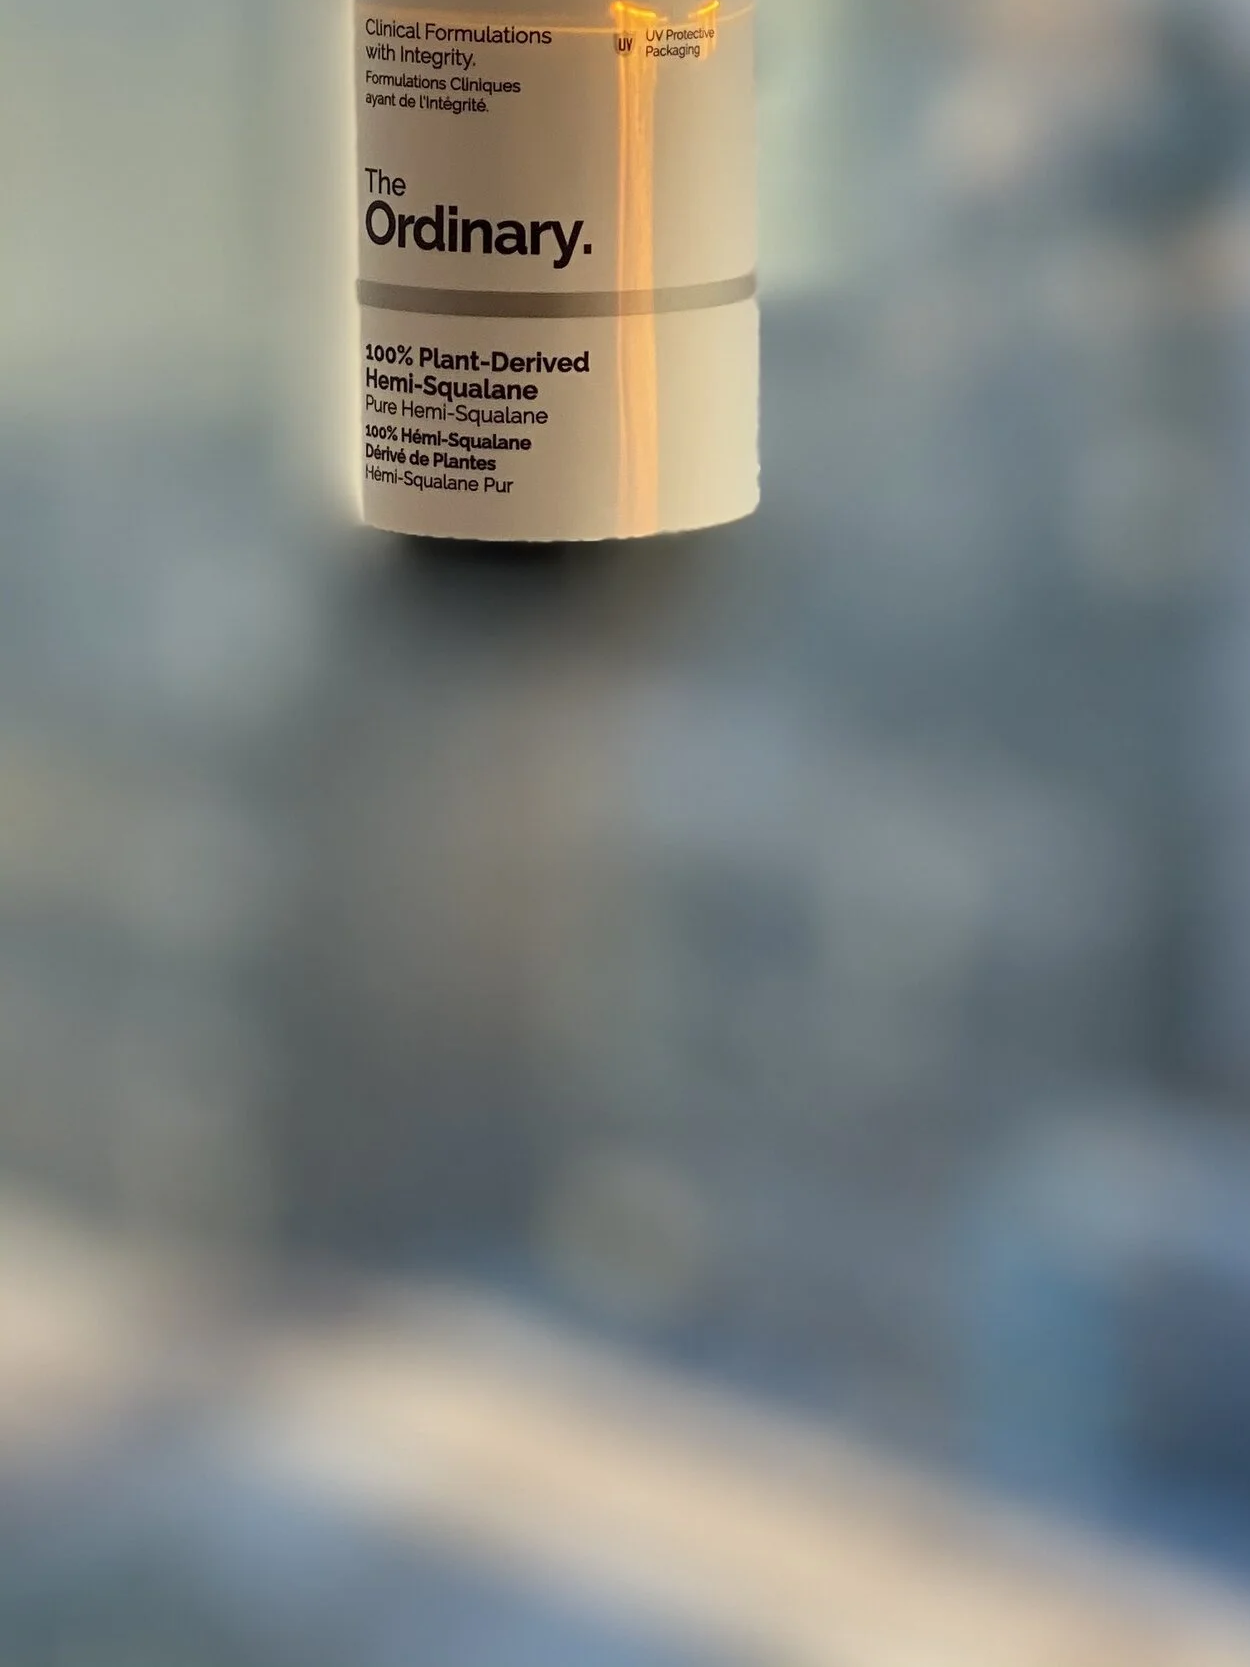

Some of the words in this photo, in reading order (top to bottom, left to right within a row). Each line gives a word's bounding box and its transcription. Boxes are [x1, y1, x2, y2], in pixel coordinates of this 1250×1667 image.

[365, 18, 421, 40] Clinical
[425, 22, 553, 45] Formulations
[618, 37, 633, 52] UV
[645, 28, 664, 42] UV
[665, 27, 715, 41] Protective
[365, 42, 396, 62] with
[400, 45, 477, 70] Integrity.
[645, 43, 700, 59] Packaging
[365, 69, 447, 90] Formulations
[450, 76, 522, 96] Cliniques
[365, 92, 396, 108] ayant
[399, 93, 416, 109] de
[364, 167, 407, 197] The
[365, 199, 593, 269] Ordinary.
[365, 343, 414, 367] 100%
[419, 347, 590, 373] Plant-Derived
[366, 366, 539, 403] Hemi-Squalane
[365, 394, 398, 416] Pure
[401, 399, 549, 427] Hemi-Squalane
[365, 423, 398, 442] 100%
[401, 427, 532, 452] Hémi-Squalane
[365, 442, 407, 464] Dérivé
[409, 449, 430, 467] de
[433, 452, 497, 471] Plantes
[365, 463, 479, 492] Hémi-Squalane
[483, 477, 514, 494] Pur
